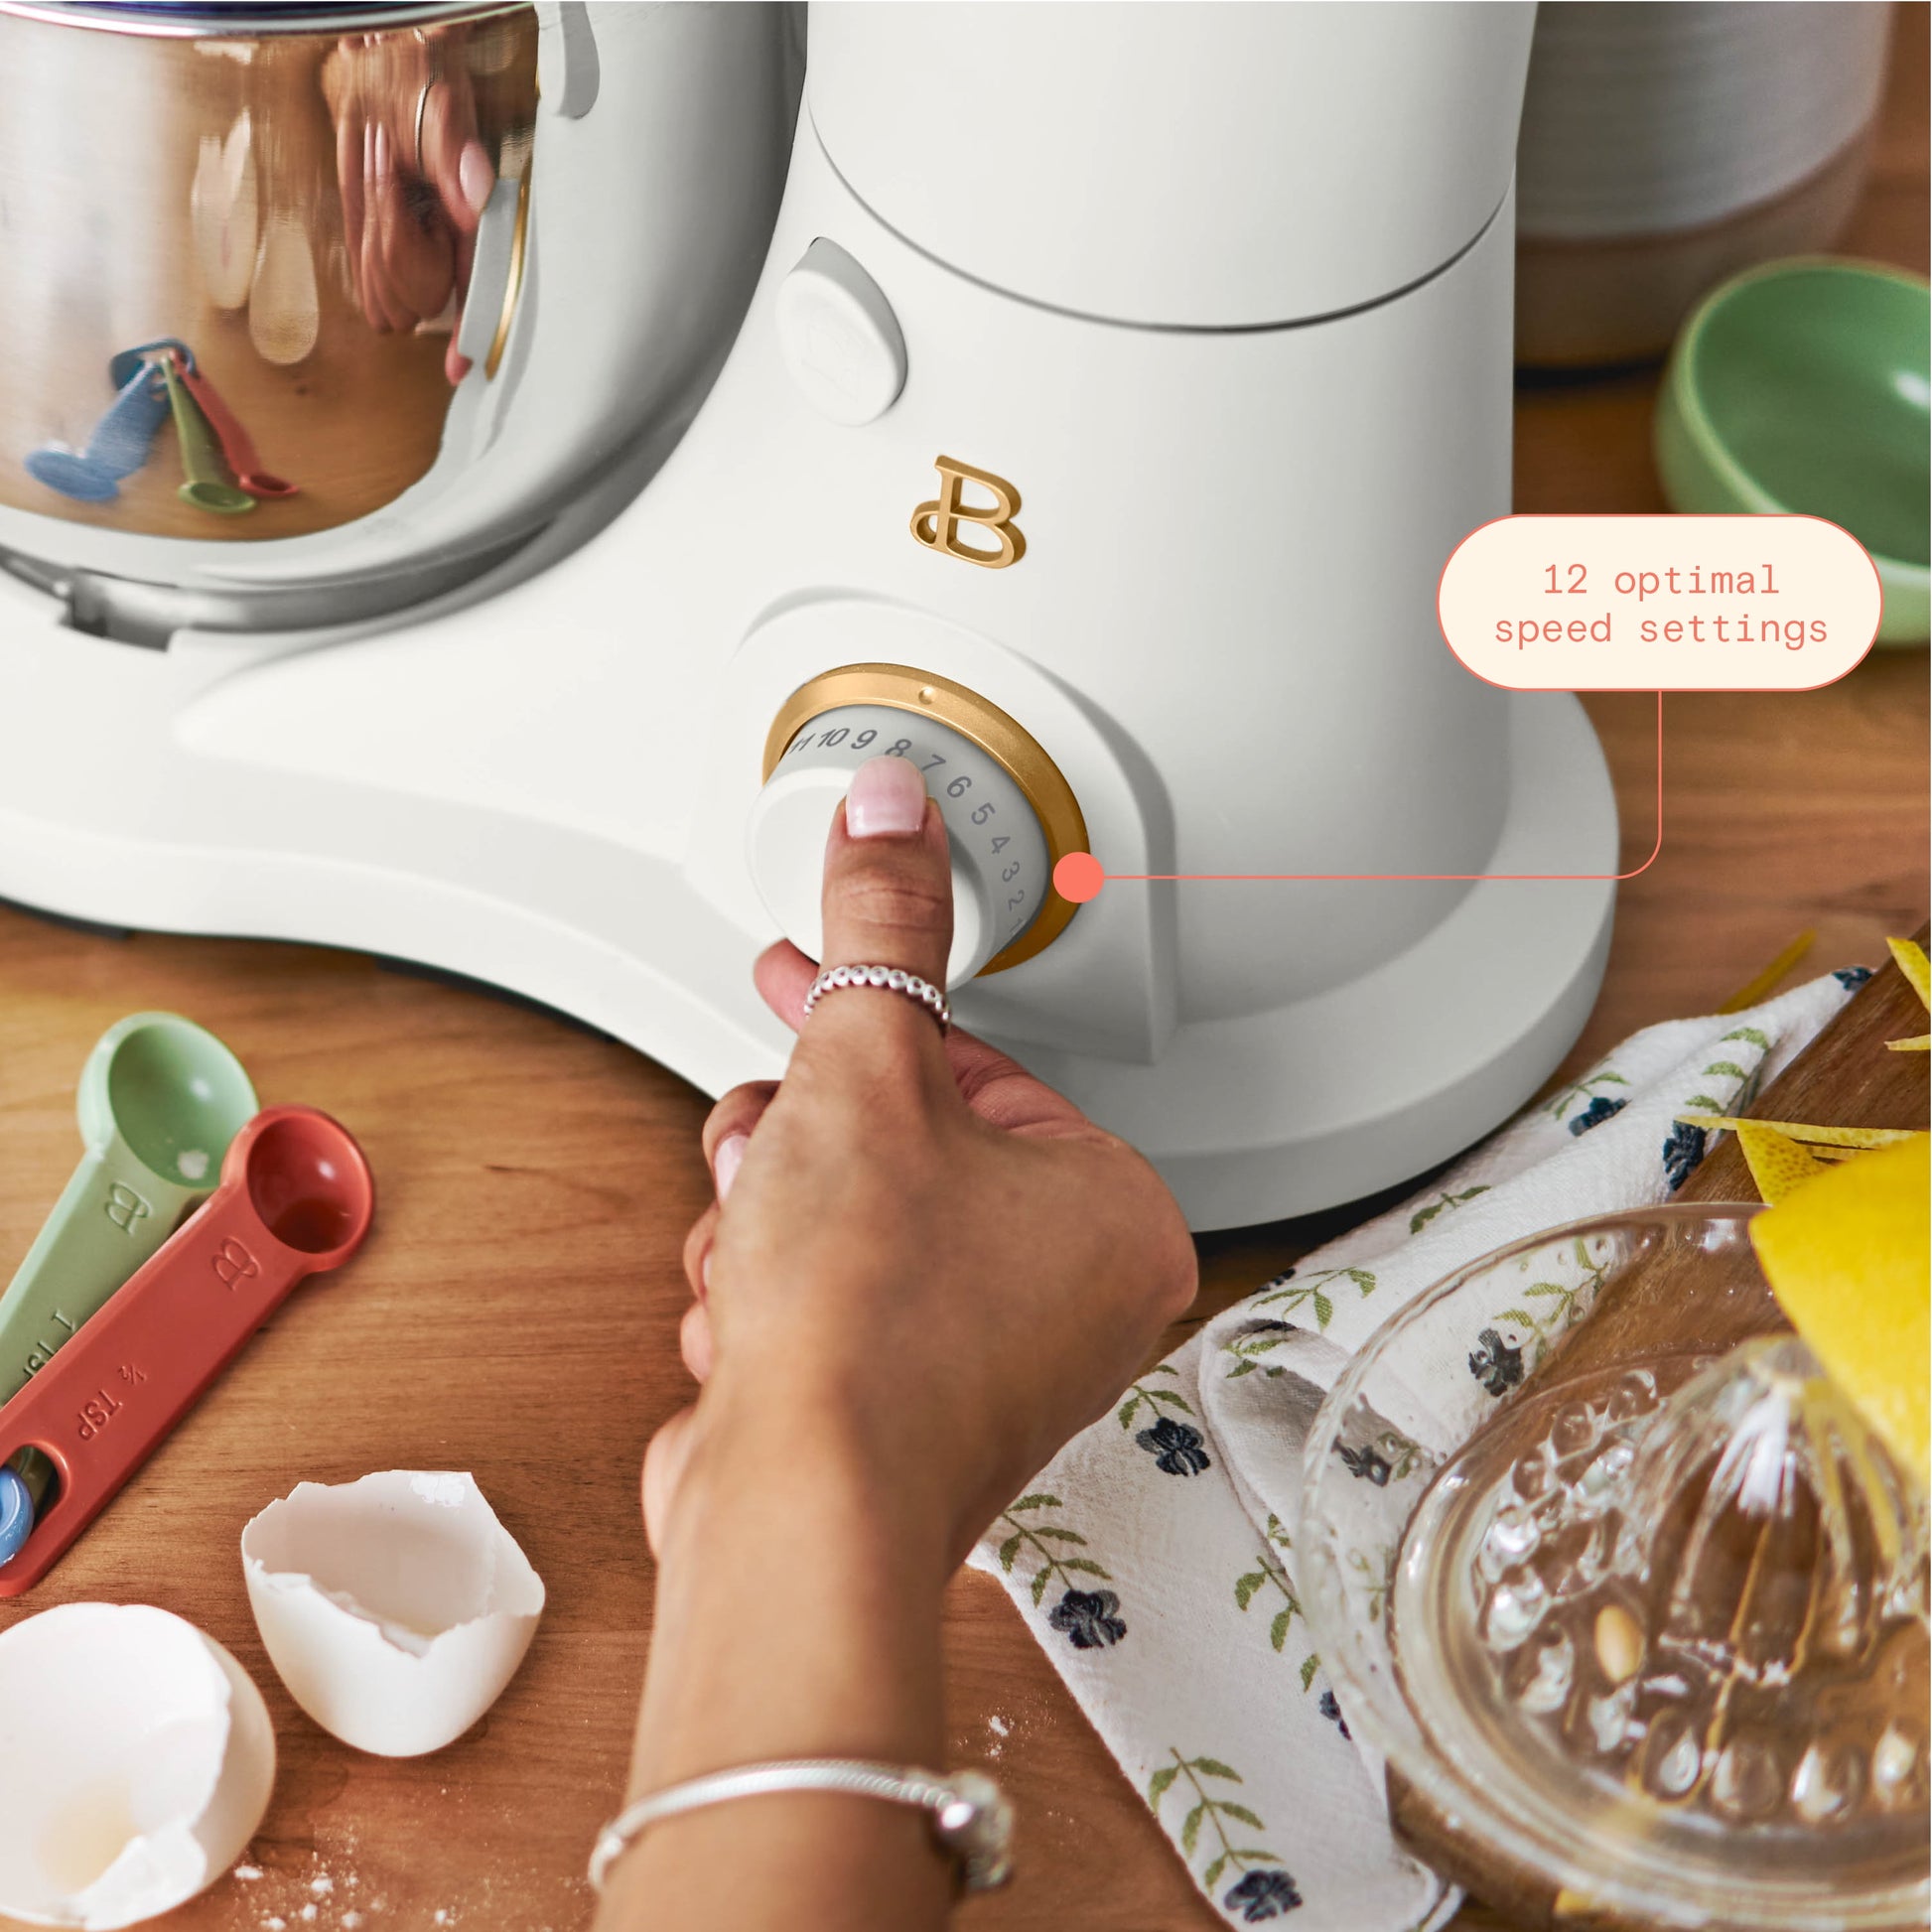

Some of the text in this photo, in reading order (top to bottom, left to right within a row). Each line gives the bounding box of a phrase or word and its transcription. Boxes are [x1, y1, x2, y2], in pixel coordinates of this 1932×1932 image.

[909, 455, 1028, 569] B
[817, 727, 851, 748] 10
[850, 729, 878, 750] 9
[884, 738, 912, 758] 8
[921, 754, 946, 772] 7
[946, 775, 972, 798] 6
[971, 802, 996, 825] 5
[991, 836, 1011, 855] 4
[1002, 861, 1021, 883] 3
[1008, 889, 1025, 911] 2
[77, 1389, 123, 1442] TSP
